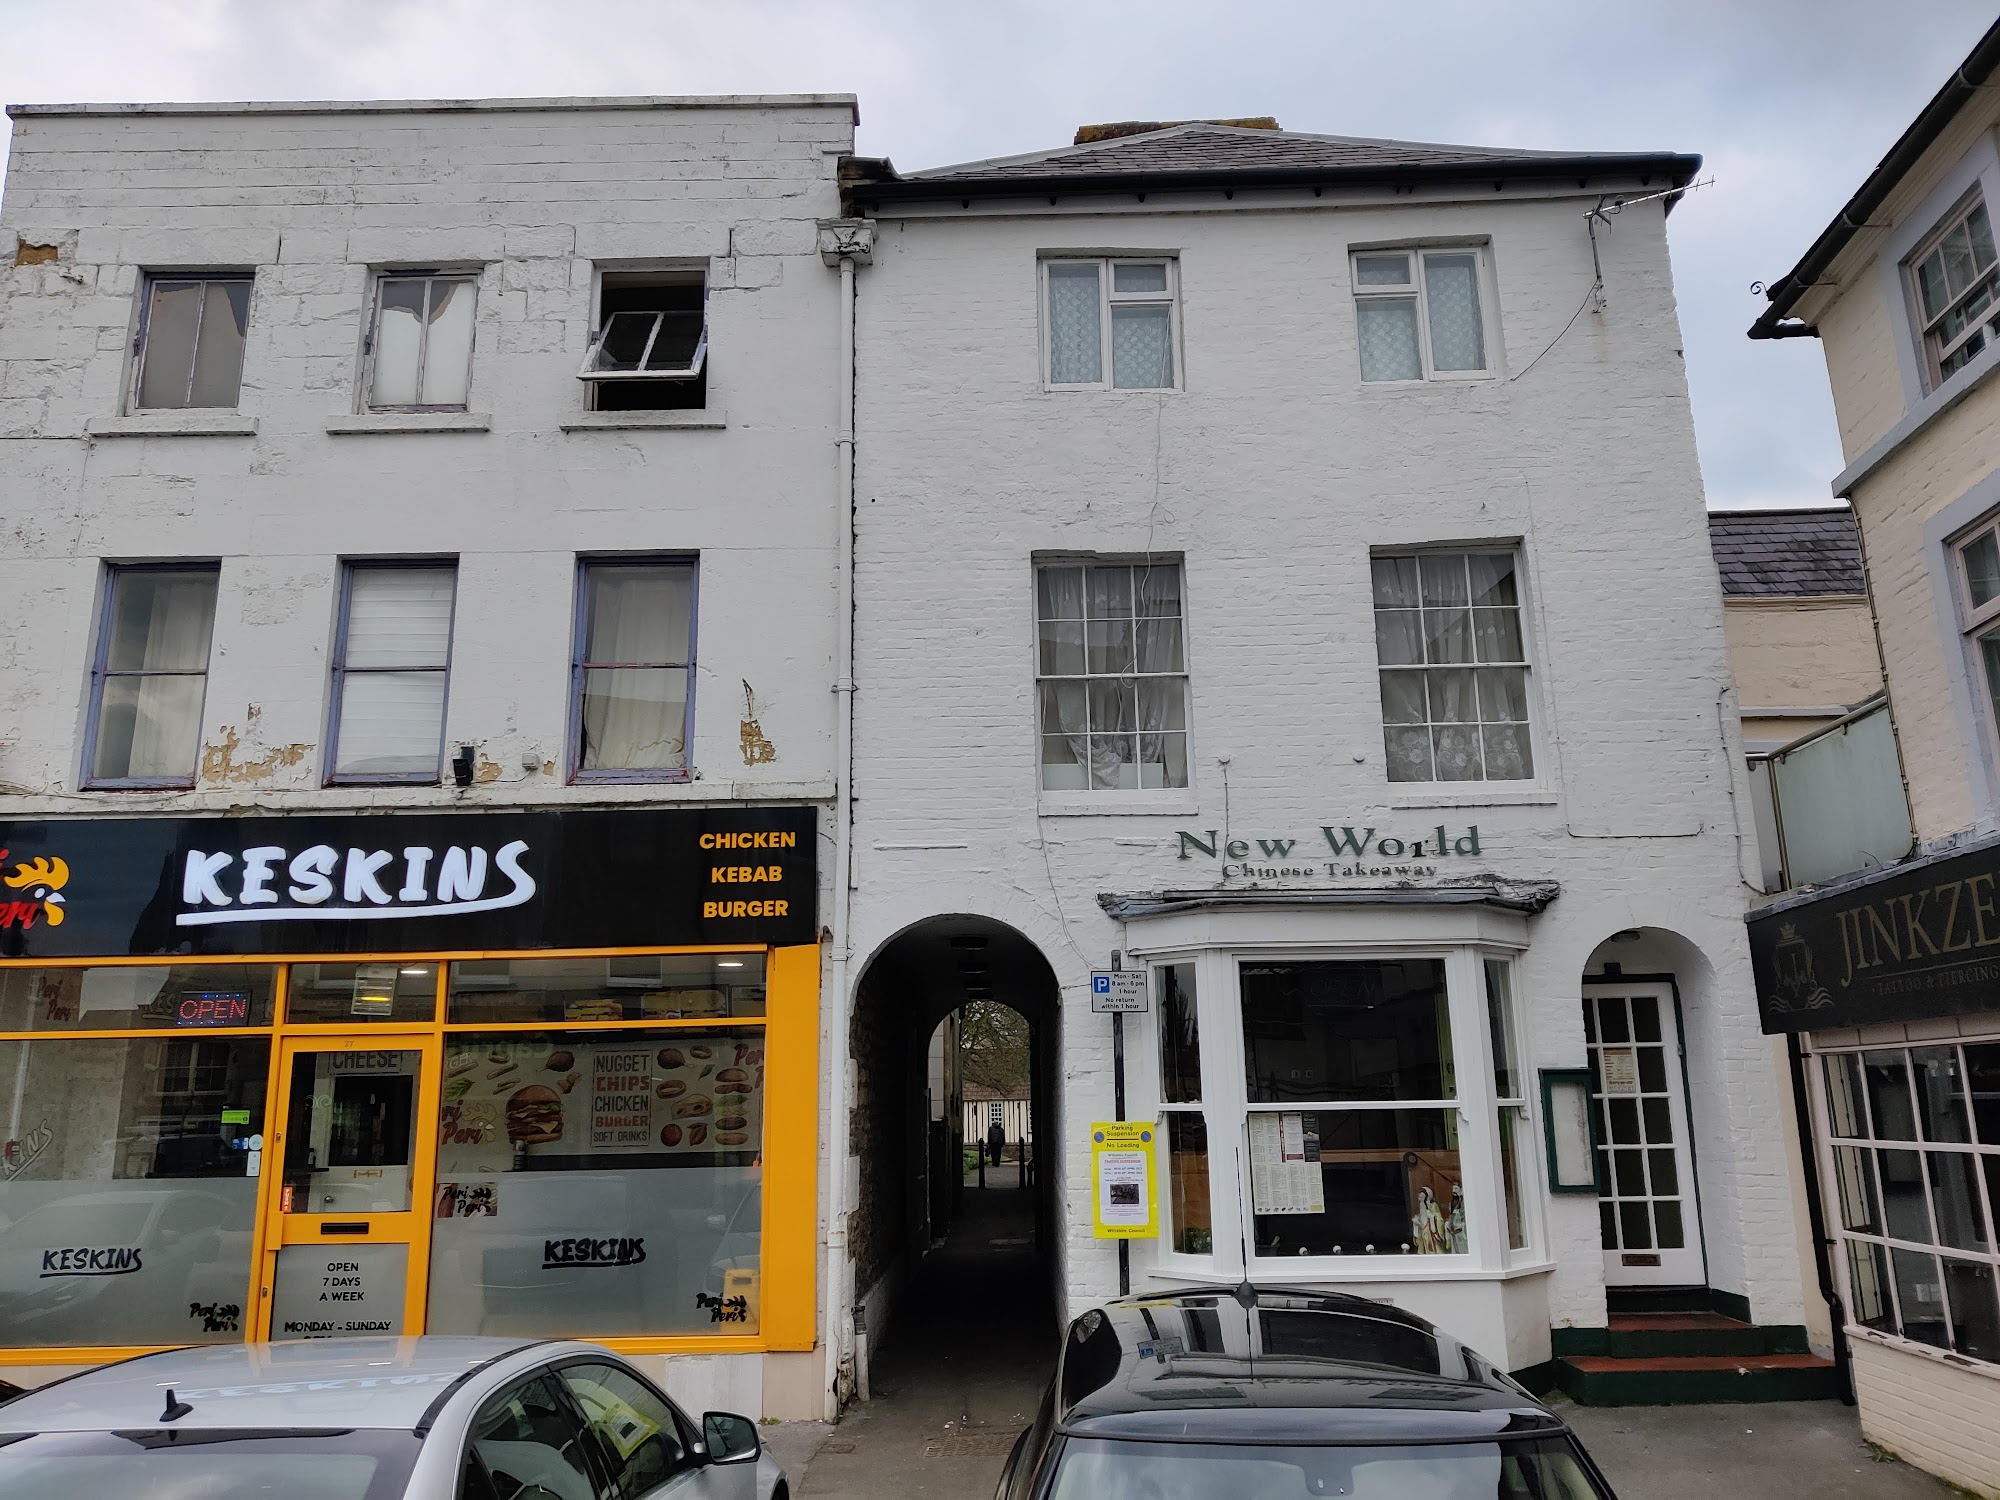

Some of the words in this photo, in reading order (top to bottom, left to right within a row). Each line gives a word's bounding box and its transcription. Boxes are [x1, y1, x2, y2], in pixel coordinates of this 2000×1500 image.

[699, 831, 796, 849] CHICKEN
[1175, 829, 1296, 859] New
[1319, 825, 1482, 859] World
[711, 866, 783, 883] KEBAB
[1222, 862, 1314, 879] Chinese
[1323, 862, 1437, 878] Takeaway
[176, 840, 536, 925] KESKINS
[703, 900, 789, 918] BURGER
[1836, 873, 2000, 987] JINKZE
[1097, 978, 1108, 992] P
[179, 999, 247, 1019] OPEN
[332, 1051, 398, 1069] CHEESE
[444, 1052, 473, 1071] RGER
[596, 1054, 650, 1073] NUGGET
[733, 1043, 765, 1067] Per
[596, 1075, 650, 1092] CHIPS
[594, 1095, 649, 1112] CHICKEN
[595, 1115, 649, 1128] BURGER
[442, 1121, 484, 1145] Peri
[593, 1131, 614, 1142] SOFT
[618, 1130, 648, 1142] DRINKS
[2, 1118, 53, 1178] KINS
[443, 1186, 469, 1201] Peri
[542, 1238, 647, 1269] KESKINS
[40, 1248, 143, 1278] KESKINS
[327, 1262, 359, 1272] OPEN
[322, 1277, 330, 1287] 7
[331, 1277, 361, 1287] DAYS
[319, 1292, 328, 1302] A
[331, 1291, 365, 1301] WEEK
[284, 1321, 335, 1332] MONDAY
[345, 1321, 392, 1331] SUNDAY
